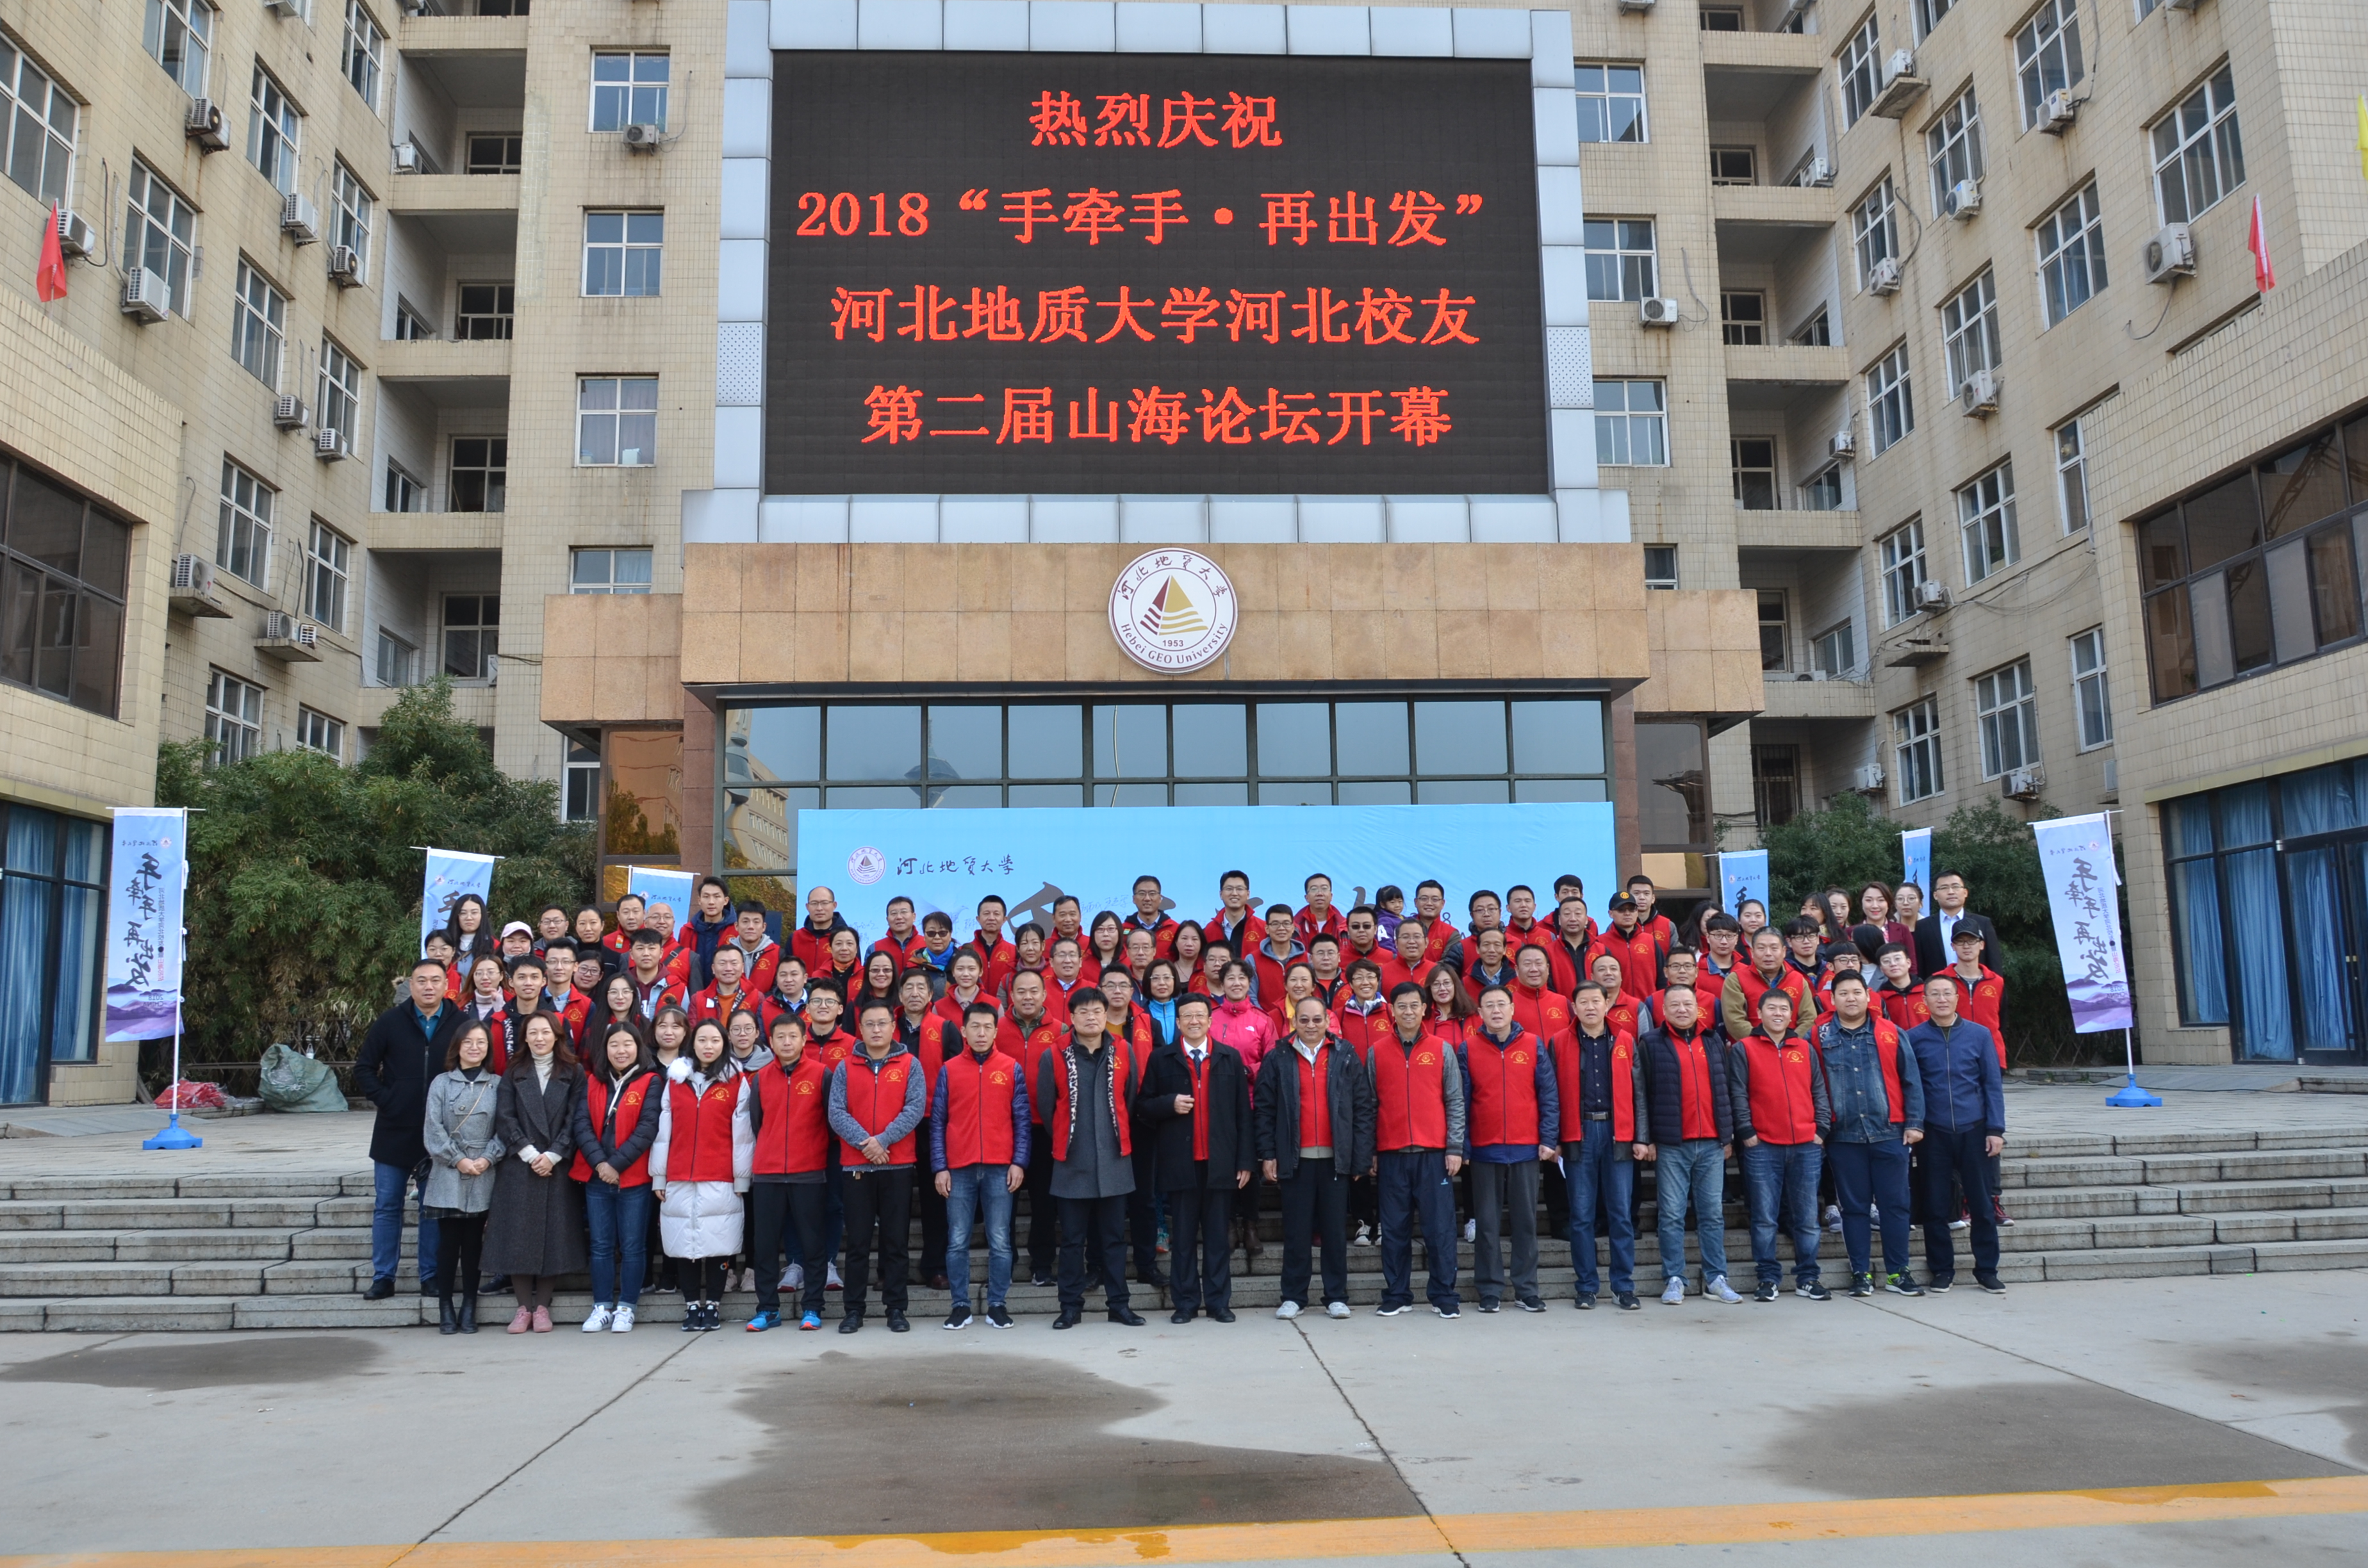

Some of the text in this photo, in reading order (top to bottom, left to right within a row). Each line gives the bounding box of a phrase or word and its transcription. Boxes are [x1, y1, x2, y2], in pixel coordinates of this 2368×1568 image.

[1029, 90, 1283, 149] 热烈庆祝
[830, 284, 1480, 345] 河北地质大学河北校友
[861, 385, 1452, 446] 第二届山海论坛开幕
[1121, 623, 1228, 664] Hebei GEO University
